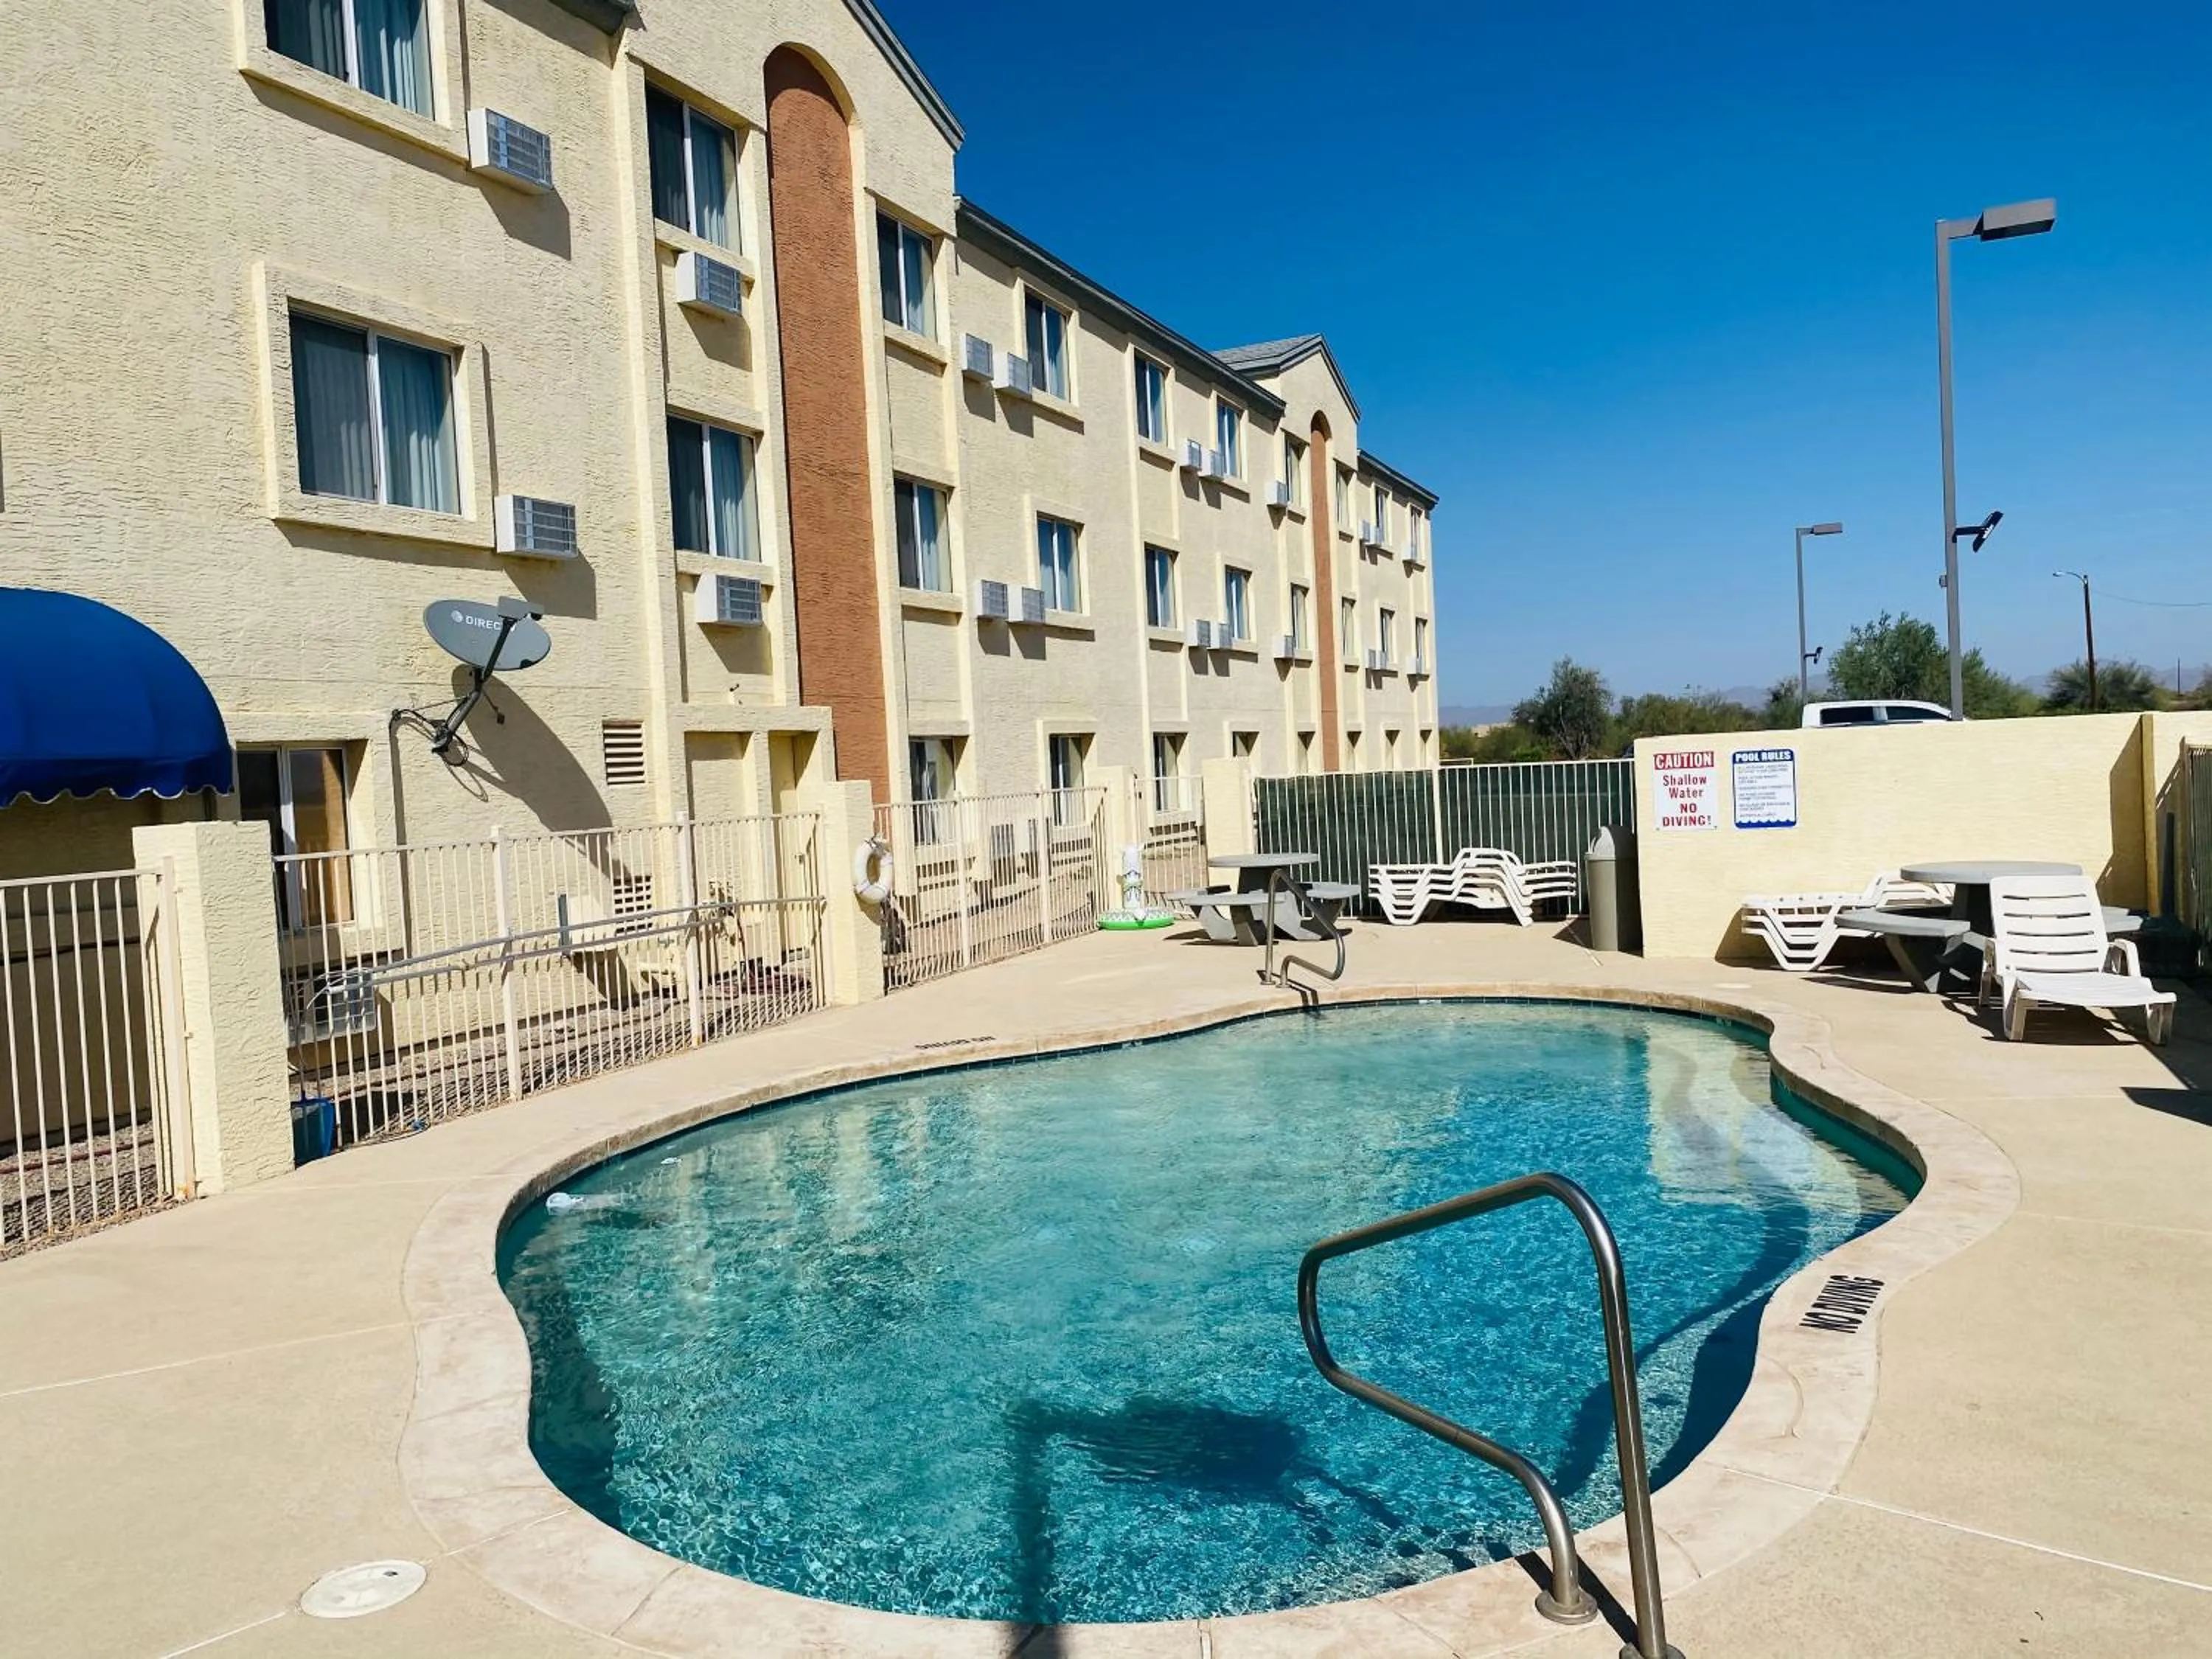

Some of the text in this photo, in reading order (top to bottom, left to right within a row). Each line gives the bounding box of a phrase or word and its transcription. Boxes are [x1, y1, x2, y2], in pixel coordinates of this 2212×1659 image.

[465, 615, 516, 632] DIREC
[1655, 753, 1712, 768] CAUTION
[1736, 751, 1791, 762] POOL RULES
[1663, 774, 1707, 786] Shallow
[1669, 787, 1703, 799] Water
[1680, 803, 1697, 813] NO
[1663, 815, 1711, 827] DIVING!
[1799, 1275, 1885, 1333] NO DIVING
